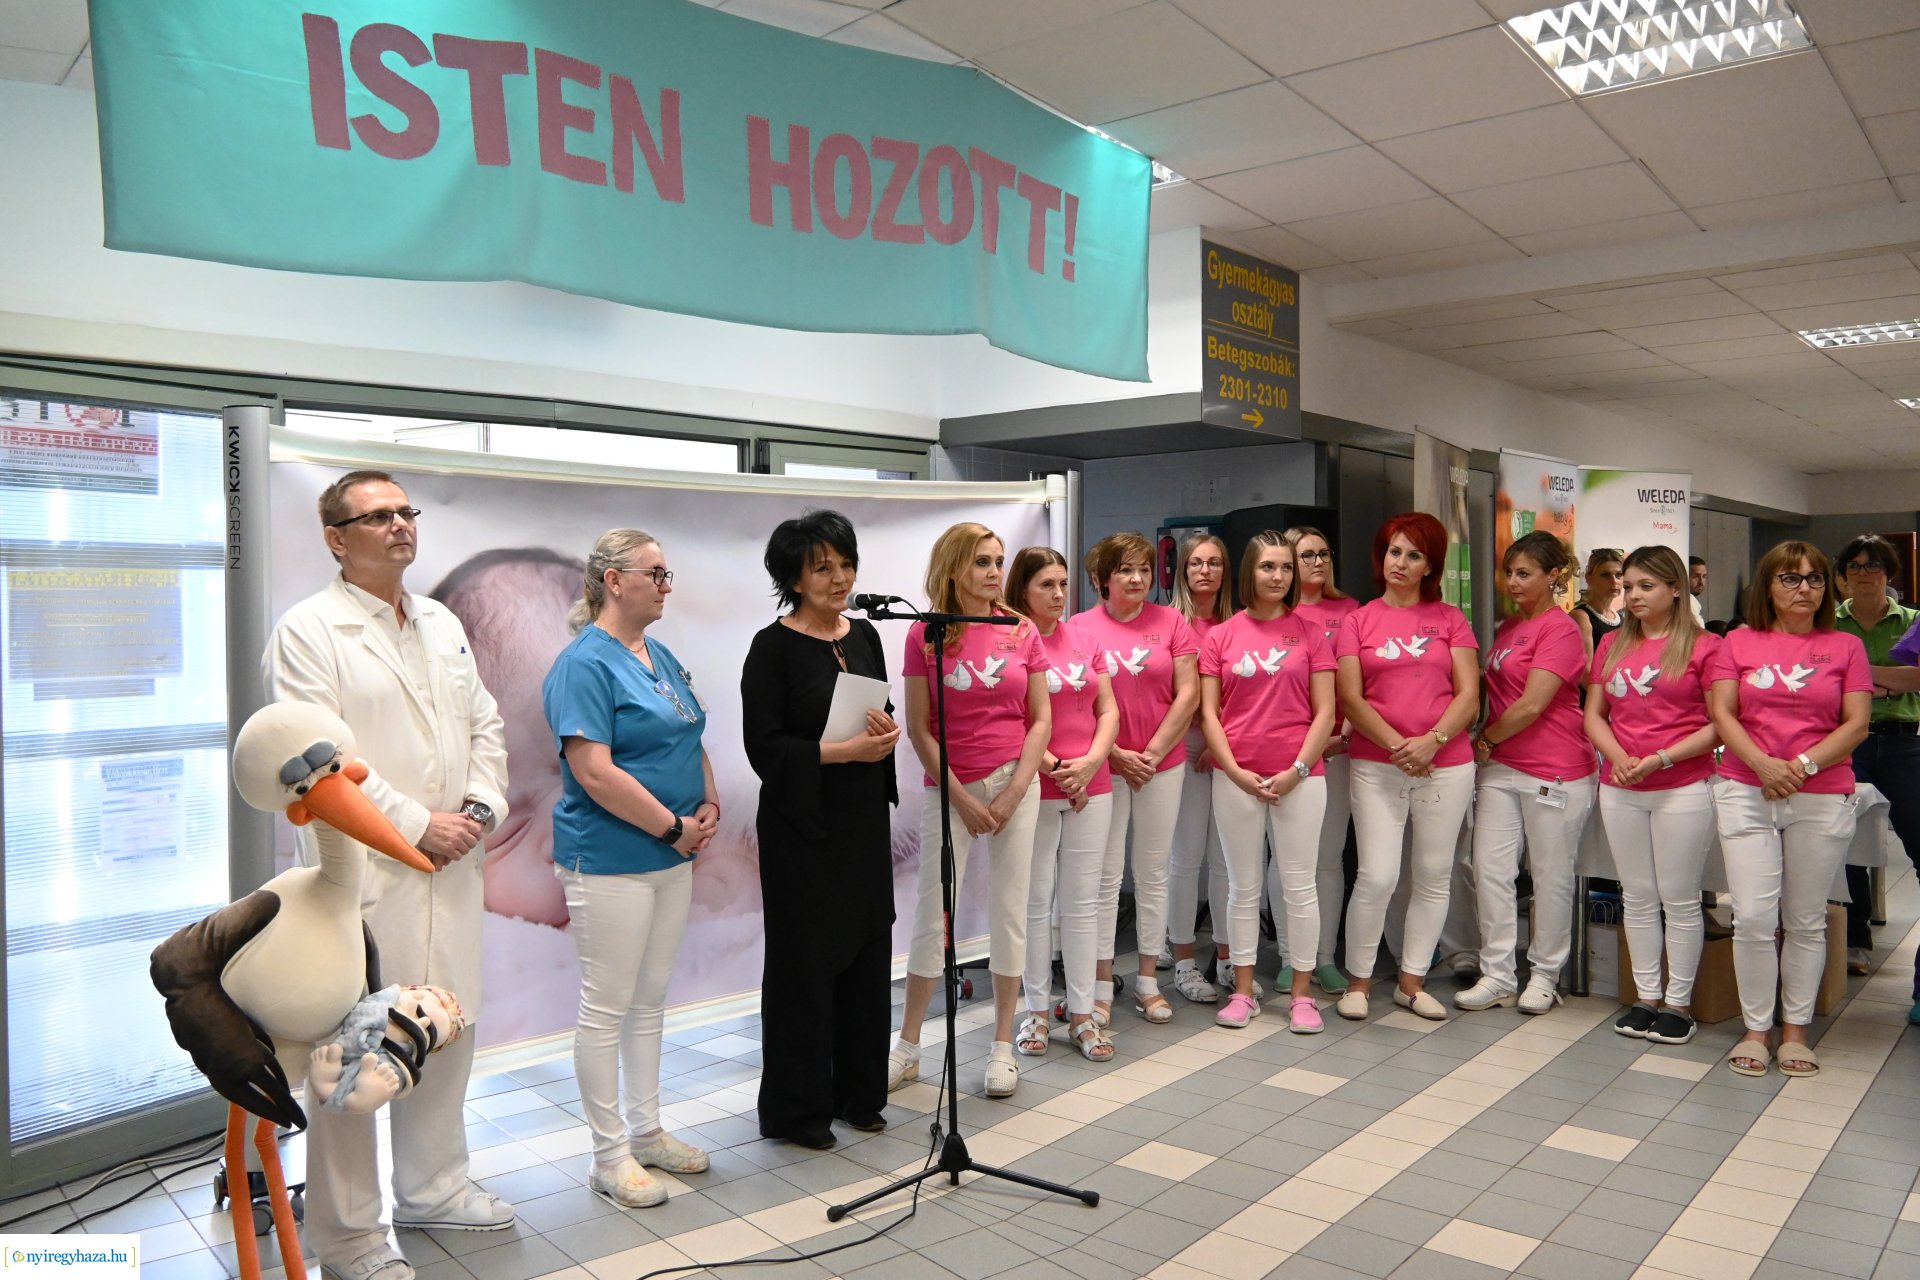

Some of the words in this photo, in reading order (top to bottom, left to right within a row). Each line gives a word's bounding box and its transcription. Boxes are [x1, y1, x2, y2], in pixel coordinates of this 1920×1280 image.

[302, 12, 685, 204] ISTEN
[746, 115, 1080, 283] HOZOTT!
[1207, 249, 1295, 306] Gyermekágyas
[1232, 301, 1275, 338] osztály
[1207, 335, 1296, 378] Betegszobák:
[1219, 374, 1288, 411] 2301-2310
[1547, 474, 1575, 493] WELEDA
[1637, 488, 1686, 505] WELEDA
[1652, 521, 1673, 530] Mama
